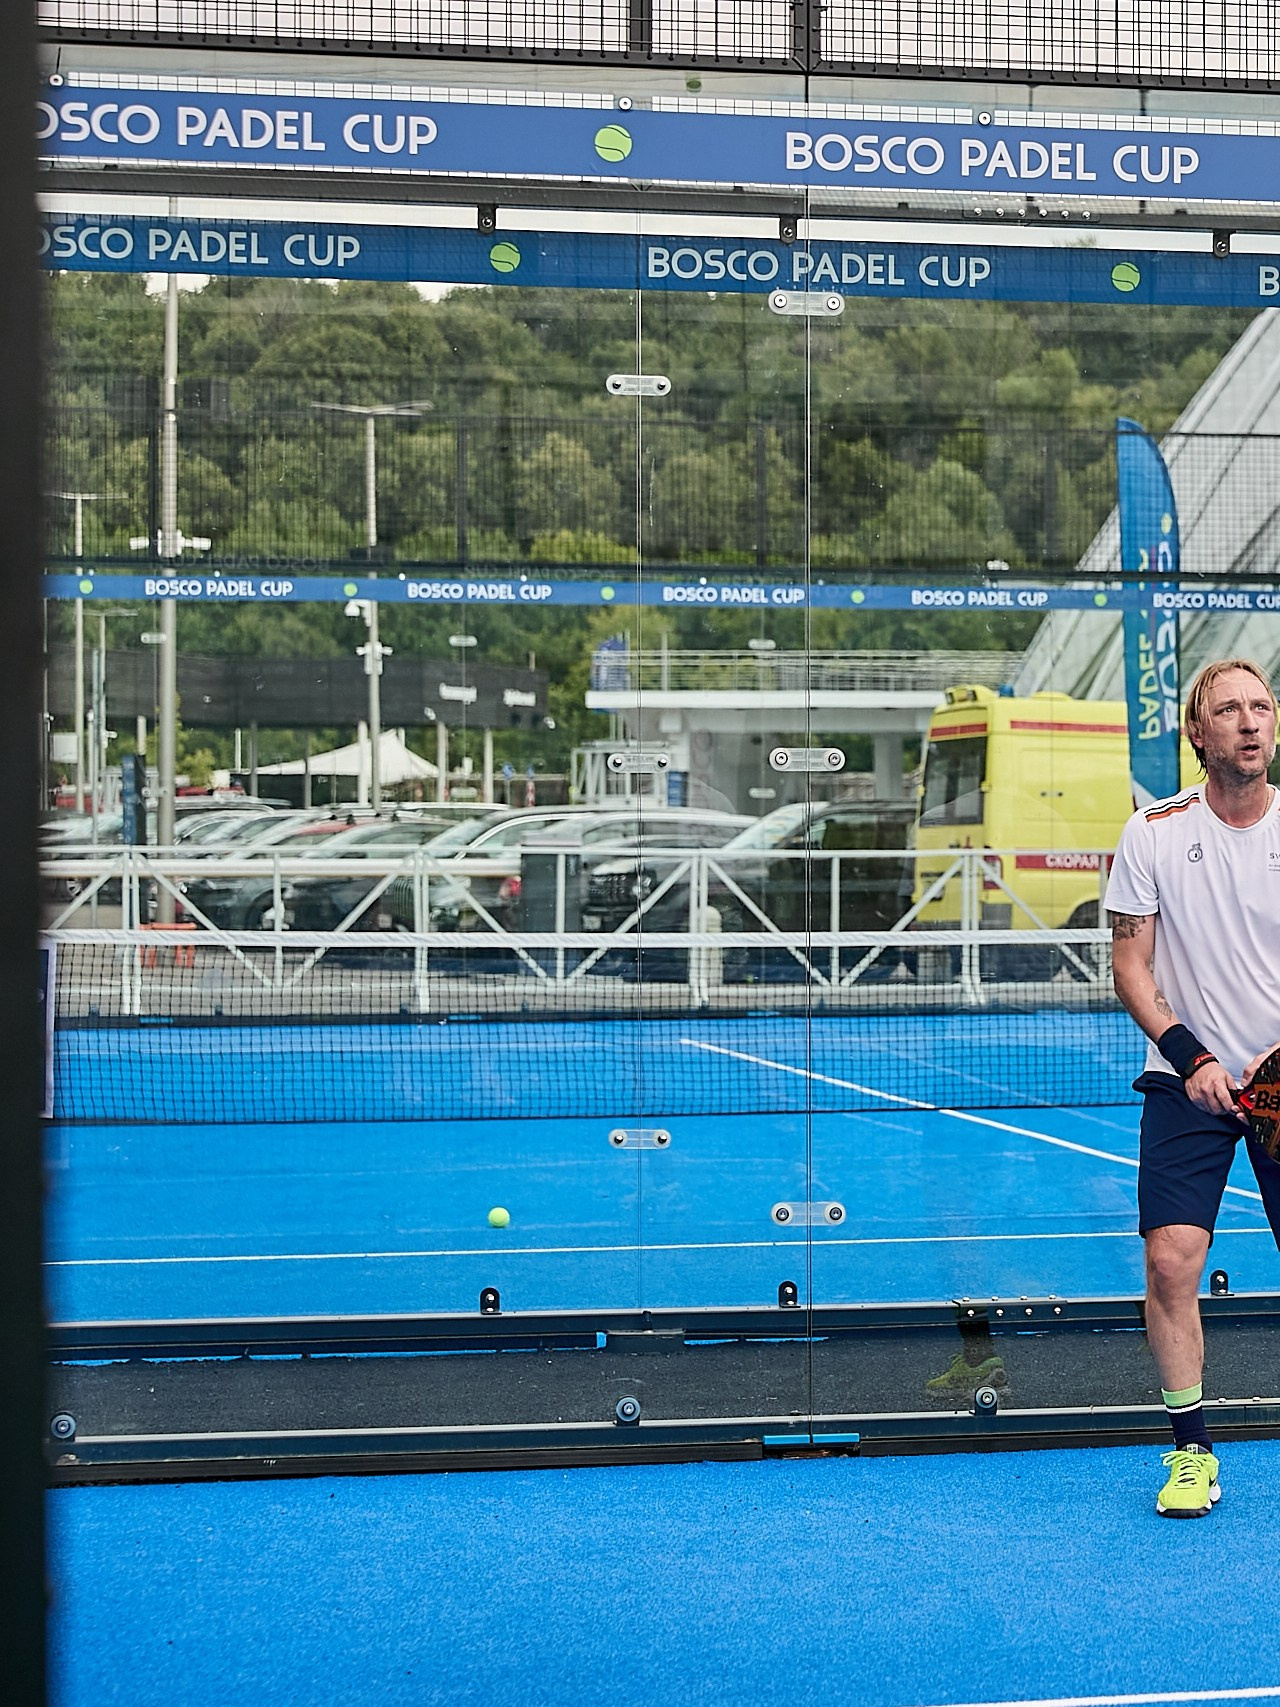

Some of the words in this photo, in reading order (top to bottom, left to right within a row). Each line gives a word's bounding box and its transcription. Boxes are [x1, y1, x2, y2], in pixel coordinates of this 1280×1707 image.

[34, 101, 161, 144] OSCO
[176, 106, 326, 151] PADEL
[342, 113, 438, 155] CUP
[786, 131, 945, 175] BOSCO
[961, 138, 1097, 181] PADEL
[1113, 144, 1200, 184] CUP
[36, 225, 134, 259] SCO
[148, 229, 269, 264] PADEL
[283, 233, 361, 267] CUP
[647, 246, 779, 281] BOSCO
[793, 251, 905, 287] PADEL
[918, 255, 991, 288] CUP
[144, 579, 203, 596] BOSCO
[206, 580, 256, 597] PADEL
[260, 581, 293, 597] CUP
[407, 582, 464, 599] BOSCO
[467, 583, 516, 600] PADEL
[519, 584, 552, 600] CUP
[662, 586, 718, 602] BOSCO
[721, 587, 769, 604] PADEL
[772, 588, 805, 604] CUP
[911, 590, 965, 606] BOSCO
[968, 590, 1015, 606] PADEL
[1017, 591, 1048, 607] CUP
[1152, 593, 1205, 608] BOSCO
[1207, 593, 1253, 609] PADEL
[1045, 854, 1100, 869] СКОРАЯ
